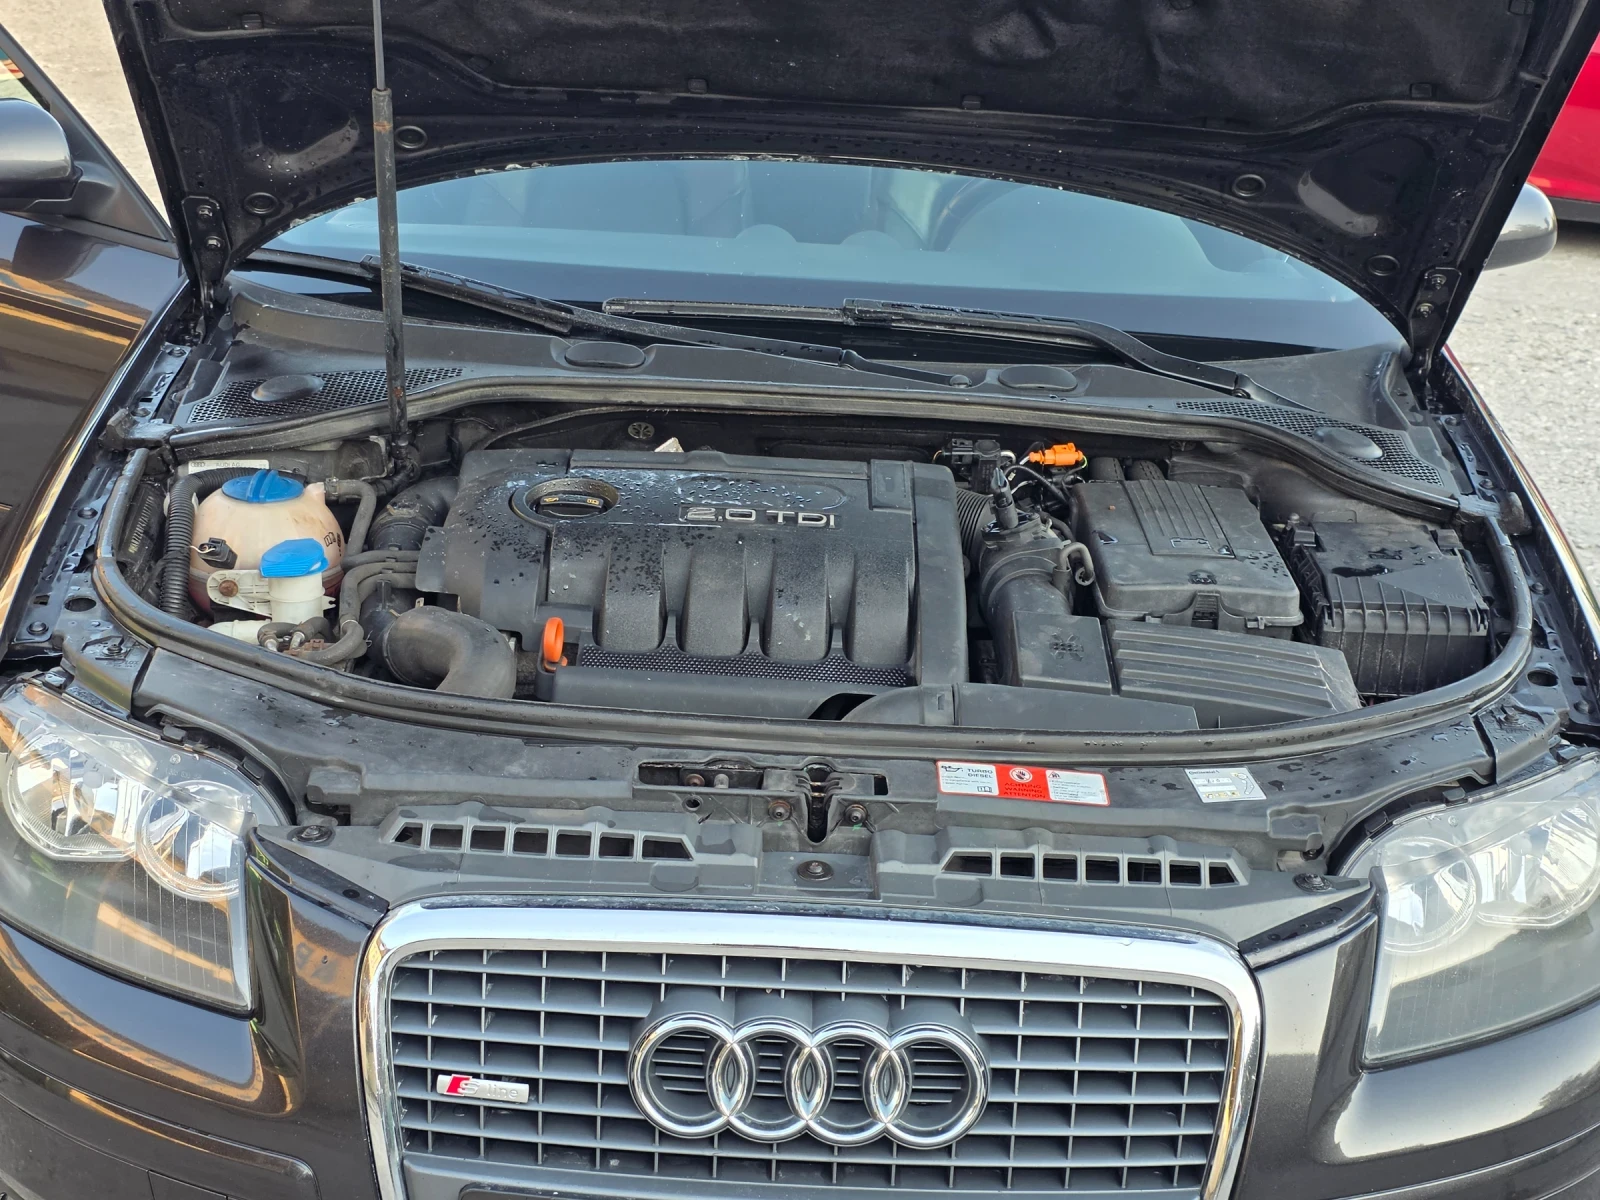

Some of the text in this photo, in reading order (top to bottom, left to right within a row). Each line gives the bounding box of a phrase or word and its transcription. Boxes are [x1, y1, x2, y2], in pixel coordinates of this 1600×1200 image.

[686, 506, 836, 529] 2.0 TDI
[1004, 791, 1046, 799] ATTENTION
[487, 1083, 519, 1099] line
